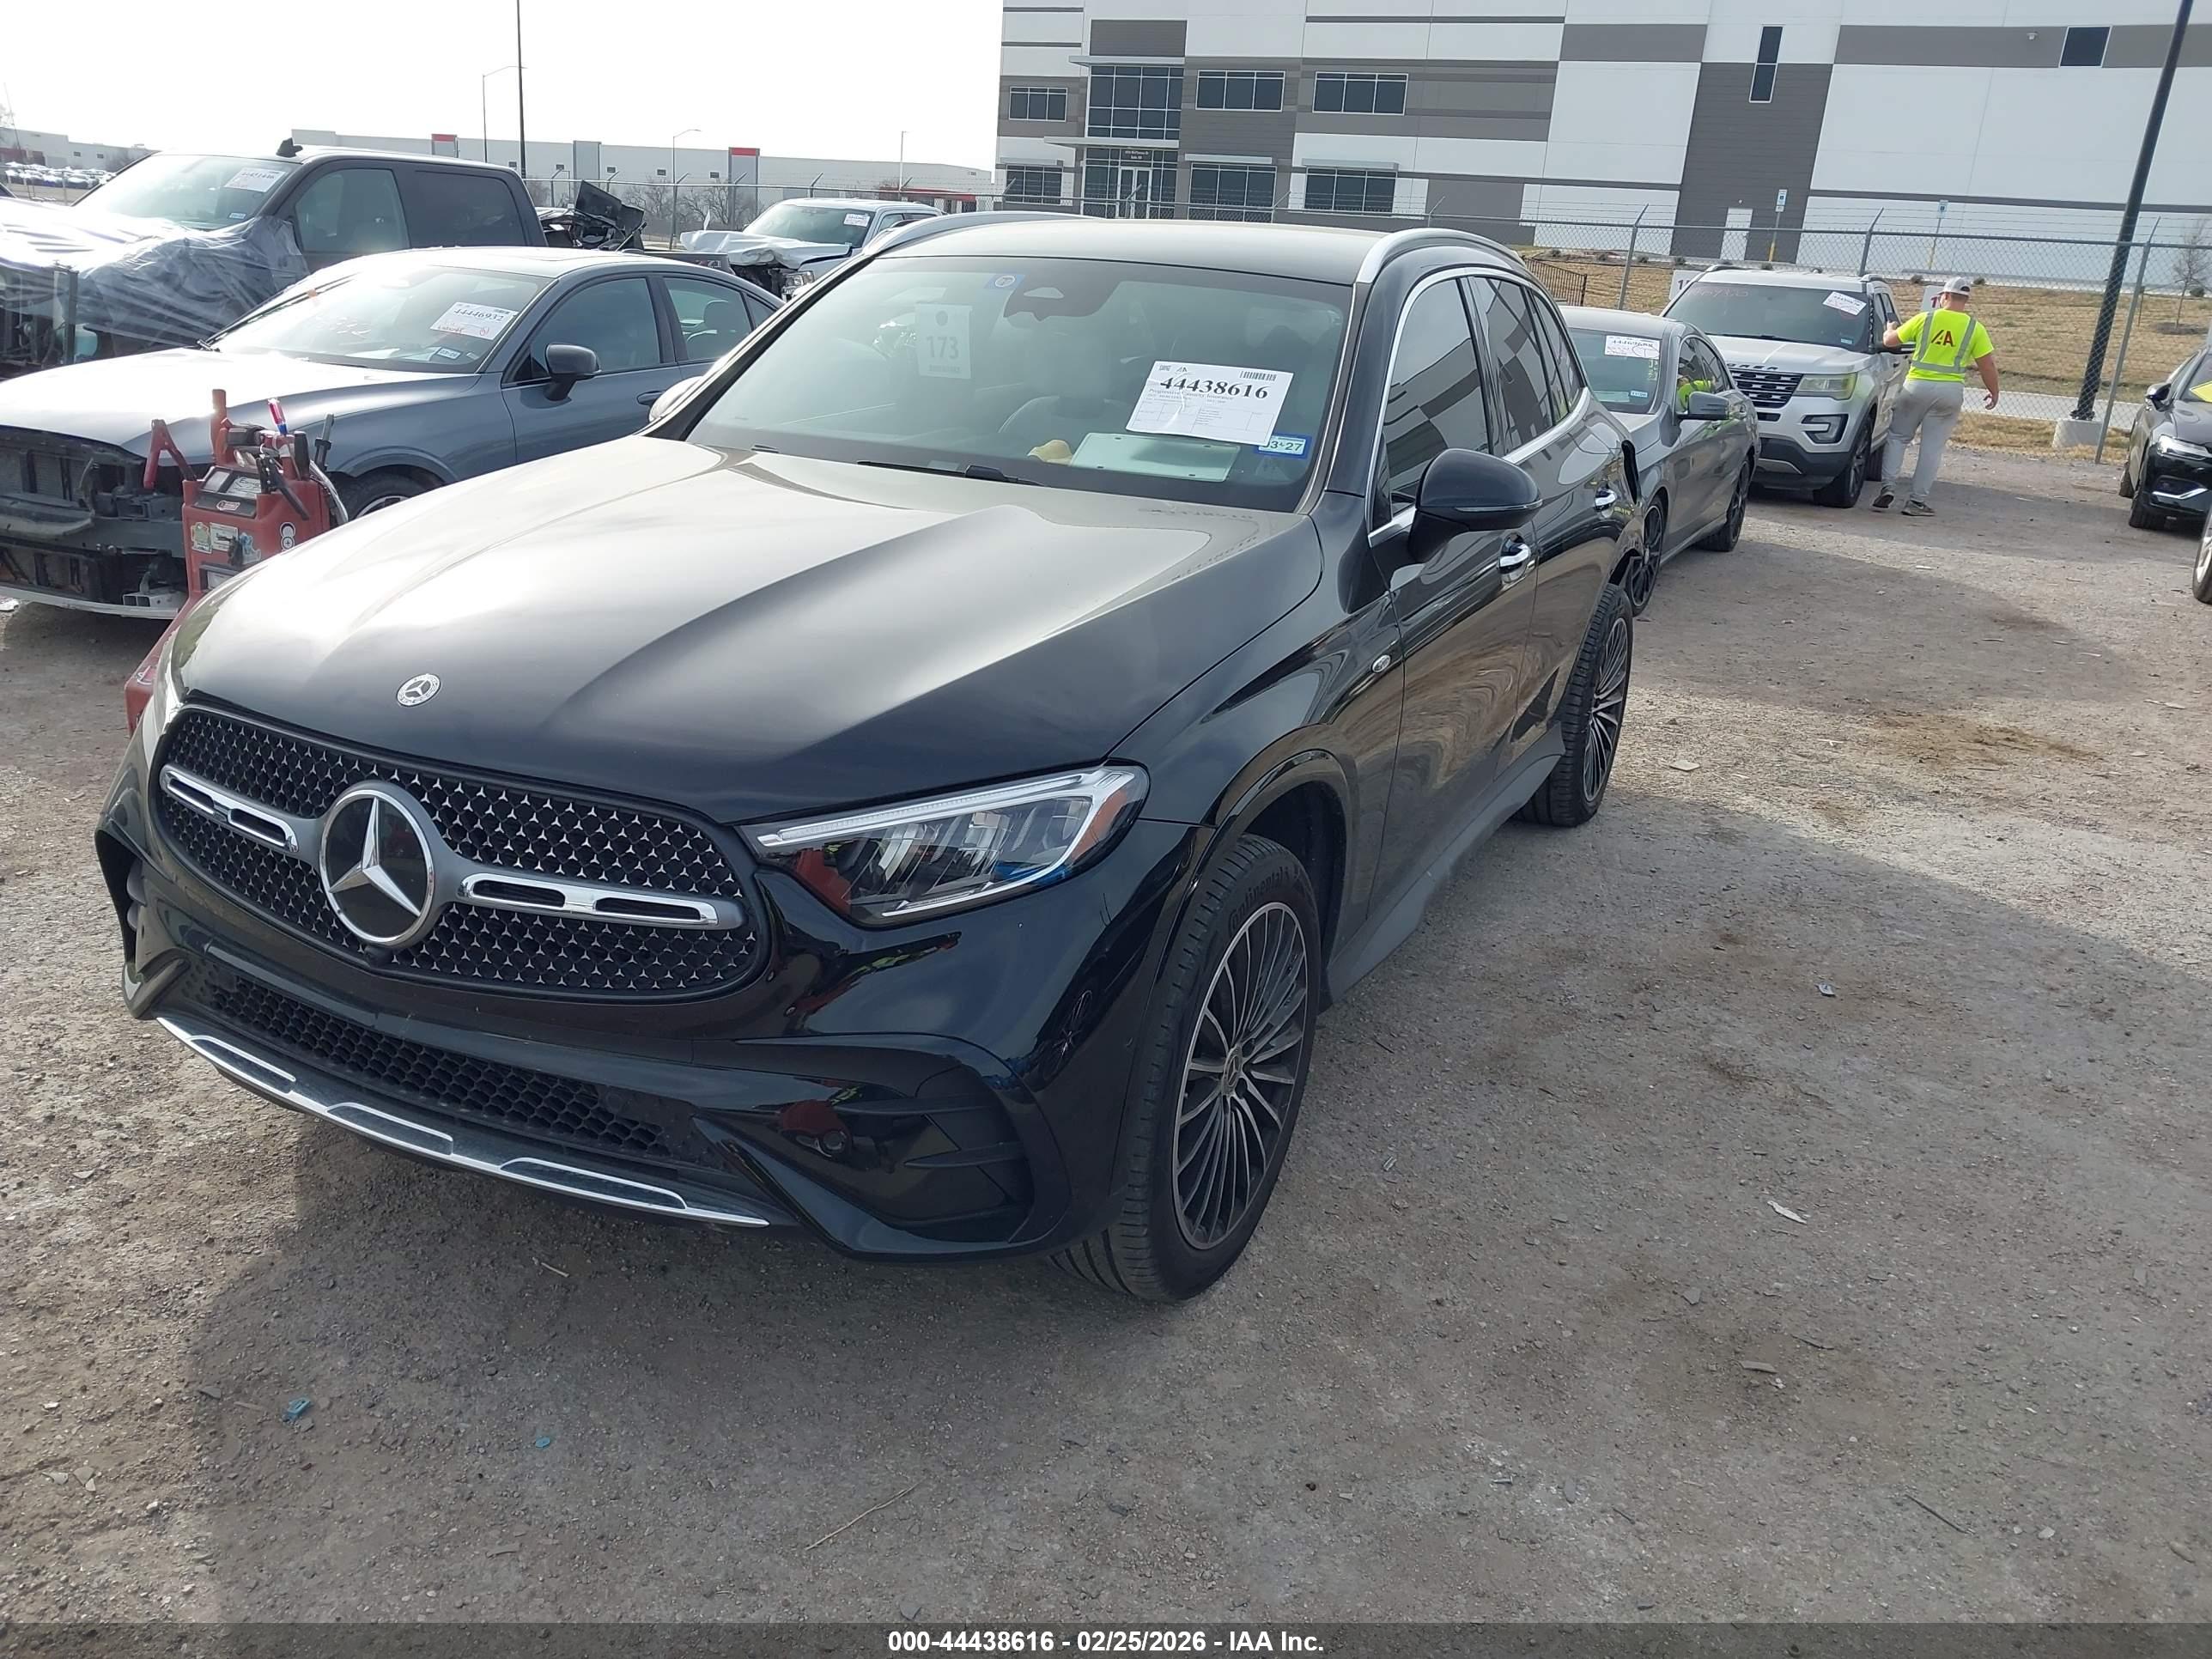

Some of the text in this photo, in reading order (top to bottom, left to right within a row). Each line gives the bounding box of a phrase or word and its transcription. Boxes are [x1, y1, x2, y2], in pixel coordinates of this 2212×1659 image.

[454, 309, 504, 321] 44446932
[927, 336, 958, 359] 173
[1159, 377, 1271, 399] 44438616
